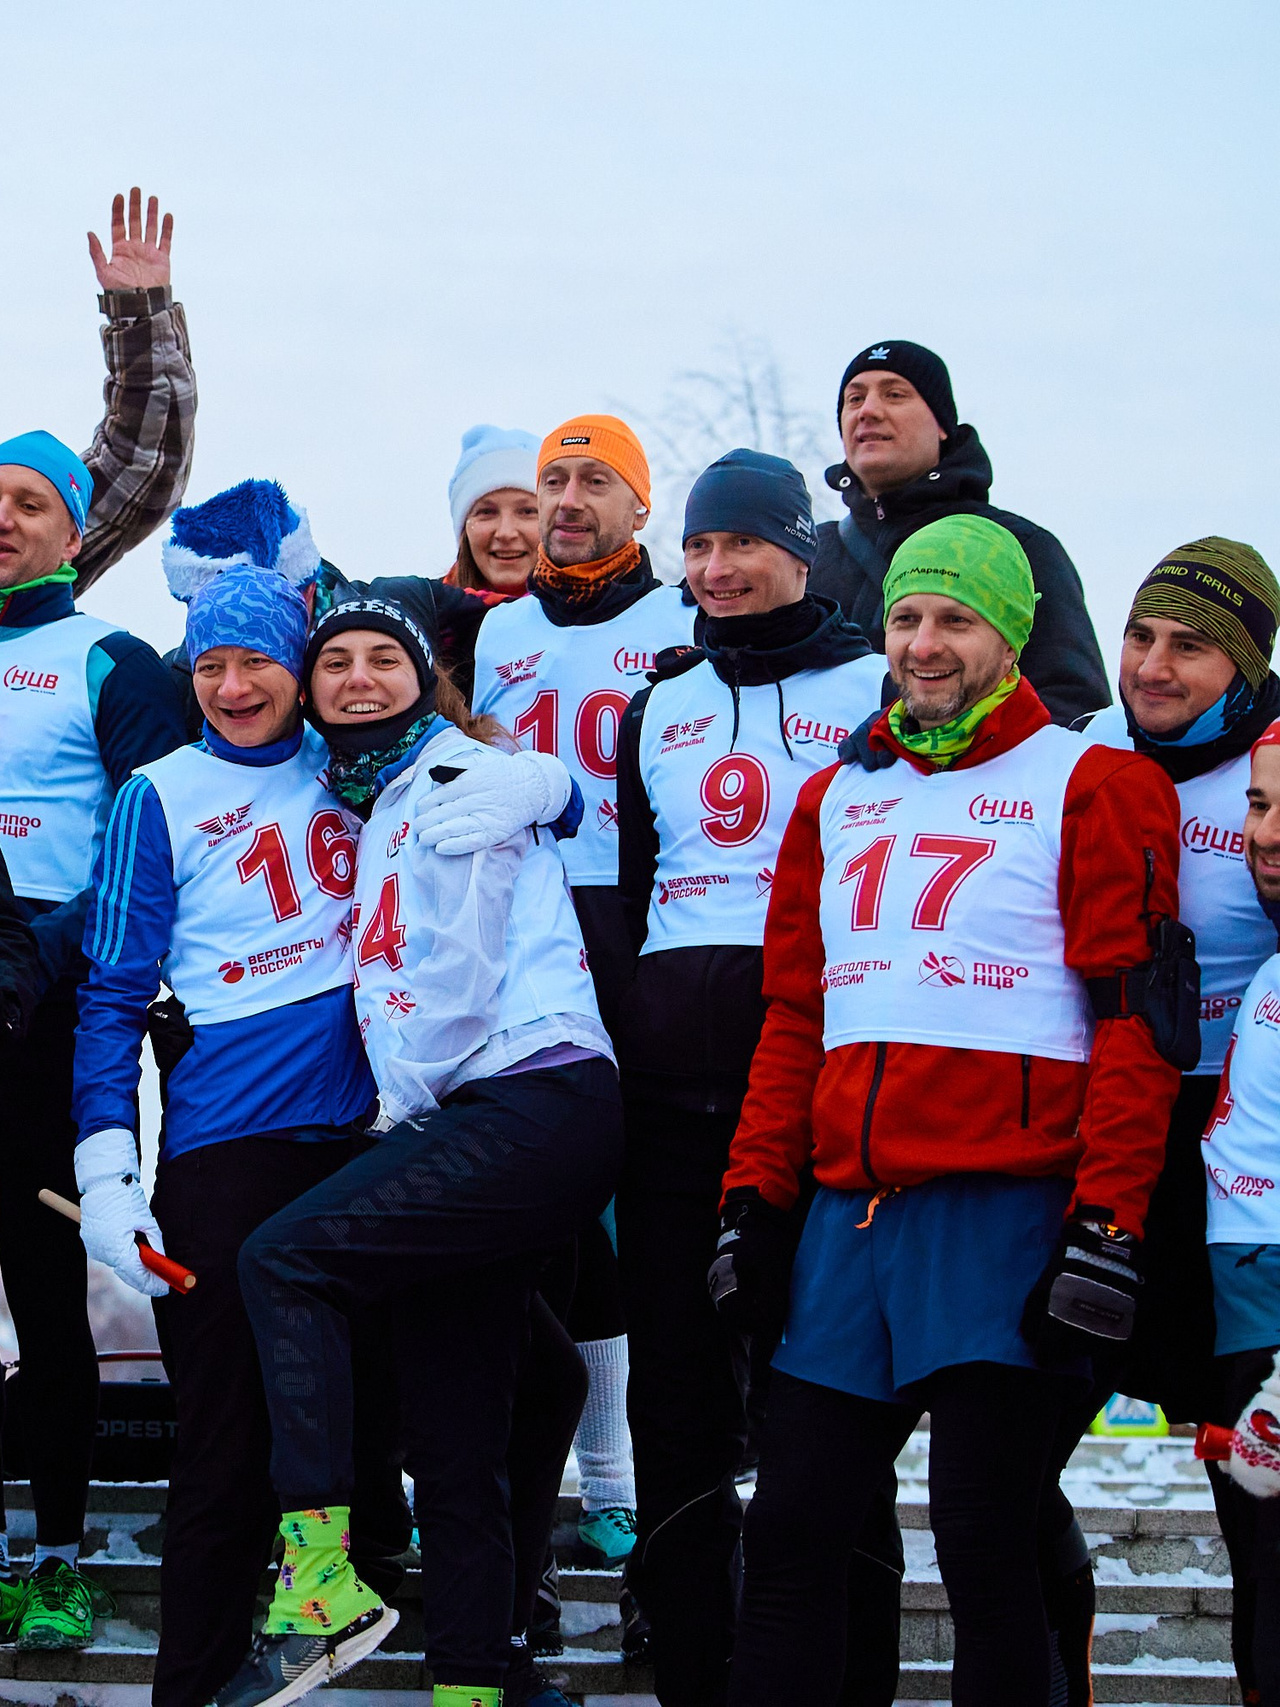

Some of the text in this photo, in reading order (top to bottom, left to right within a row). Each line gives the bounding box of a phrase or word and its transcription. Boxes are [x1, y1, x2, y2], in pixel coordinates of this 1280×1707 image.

[1195, 570, 1244, 607] TRAILS
[624, 652, 657, 672] НЦ
[11, 669, 58, 690] НЦВ
[514, 689, 633, 781] 10
[700, 752, 770, 848] 9
[979, 798, 1034, 821] НЦВ
[1190, 822, 1245, 854] НЦВ
[236, 809, 358, 923] 16
[668, 874, 729, 889] ВЕРТОЛЕТЫ
[839, 833, 996, 932] 17
[248, 937, 324, 965] ВЕРТОЛЕТЫ
[250, 955, 303, 977] РОССИИ
[828, 960, 891, 977] ВЕРТОЛЕТЫ
[973, 962, 1029, 978] ППОО
[829, 973, 864, 988] РОССИИ
[973, 975, 1014, 990] НЦВ
[1200, 996, 1241, 1010] ПОО
[1198, 1008, 1225, 1021] ЦВ
[1234, 1175, 1275, 1189] ППОО
